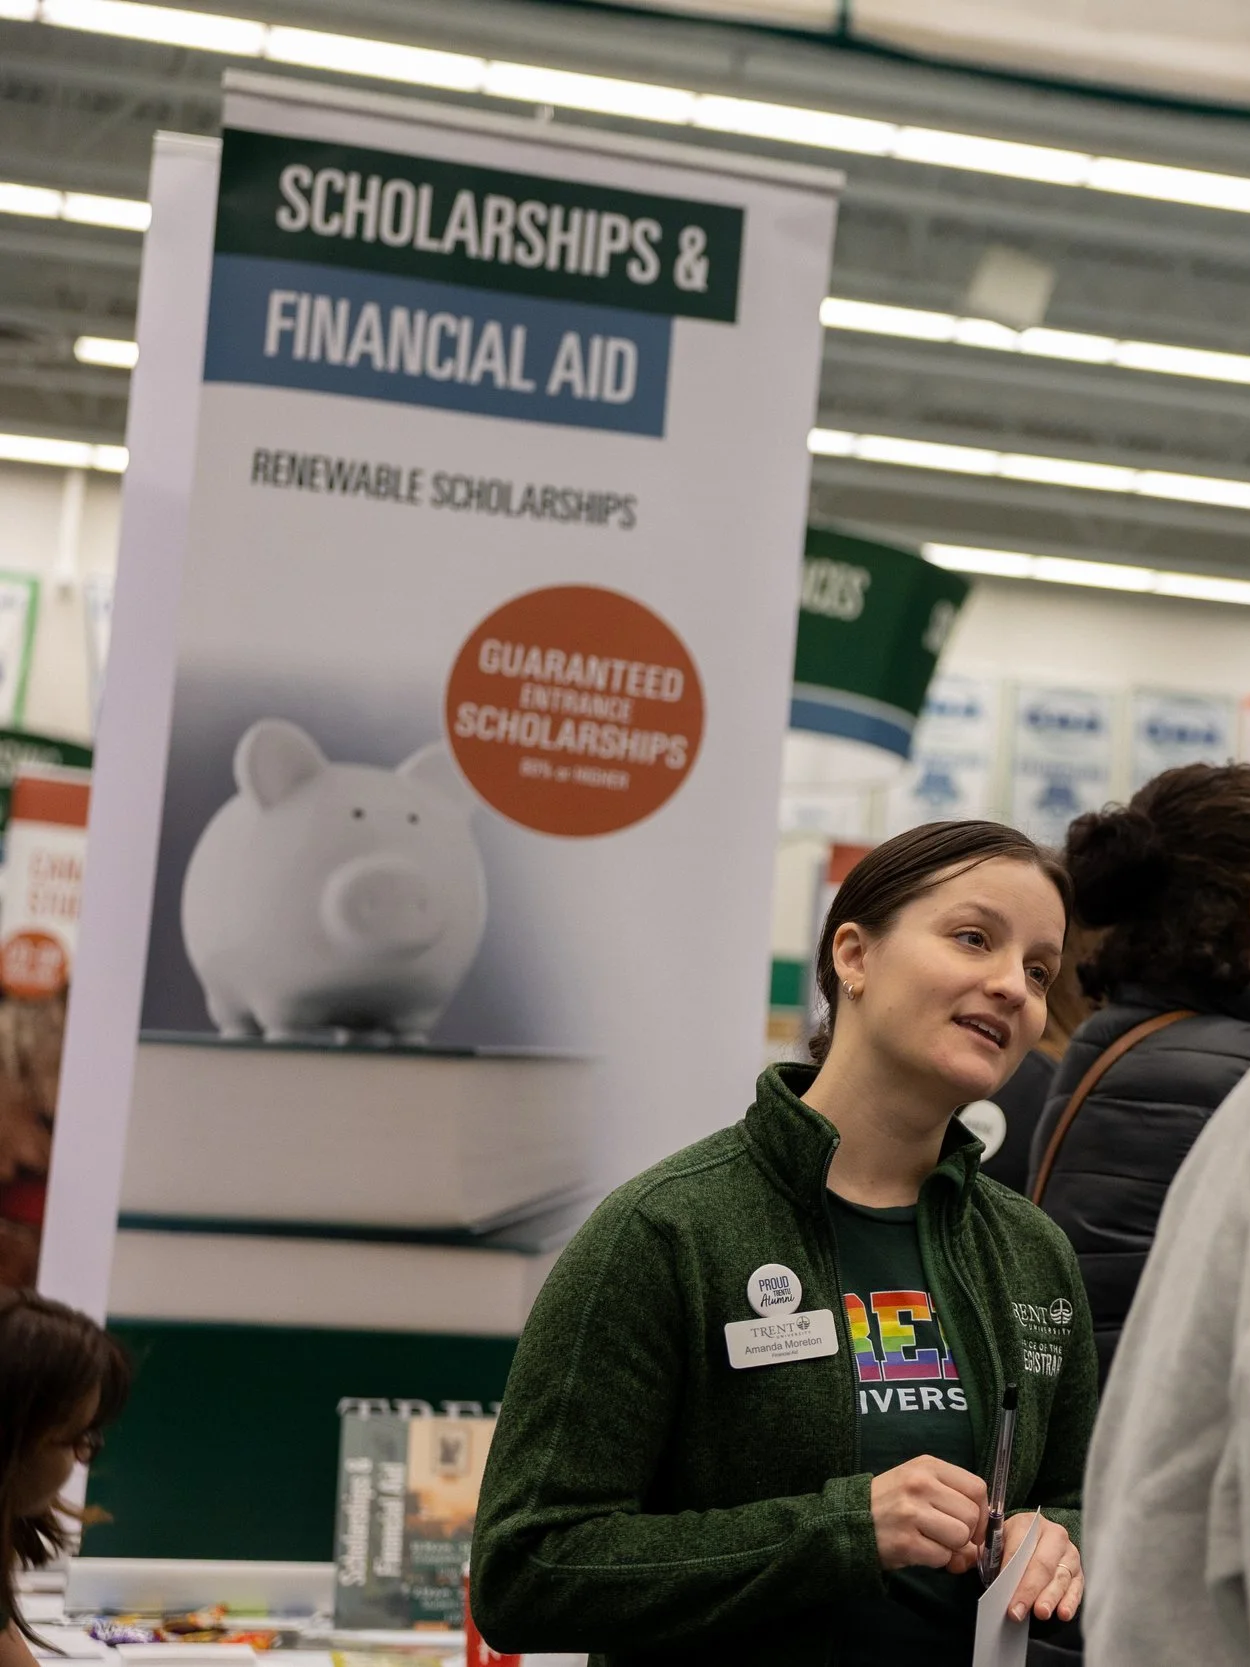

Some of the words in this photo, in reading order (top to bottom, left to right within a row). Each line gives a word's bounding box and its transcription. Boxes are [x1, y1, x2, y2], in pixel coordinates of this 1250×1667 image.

[275, 163, 662, 285] SCHOLARSHIPS
[673, 225, 709, 292] &
[263, 289, 535, 392] FINANCIAL
[545, 331, 639, 405] AID
[251, 447, 424, 507] RENEWABLE
[430, 471, 638, 530] SCHOLARSHIPS
[478, 637, 685, 703] GUARANTEED
[518, 682, 634, 725] ENTRANCE
[454, 701, 689, 770] SCHOLARSHIPS
[759, 1276, 789, 1292] PROUD
[760, 1294, 796, 1308] Alumni
[750, 1322, 795, 1339] TRENT
[776, 1330, 811, 1339] UNIVERSITY
[1028, 1323, 1071, 1335] UNIVERSITY
[745, 1341, 783, 1355] Amanda
[784, 1337, 822, 1350] Moreton
[1049, 1343, 1063, 1355] THE
